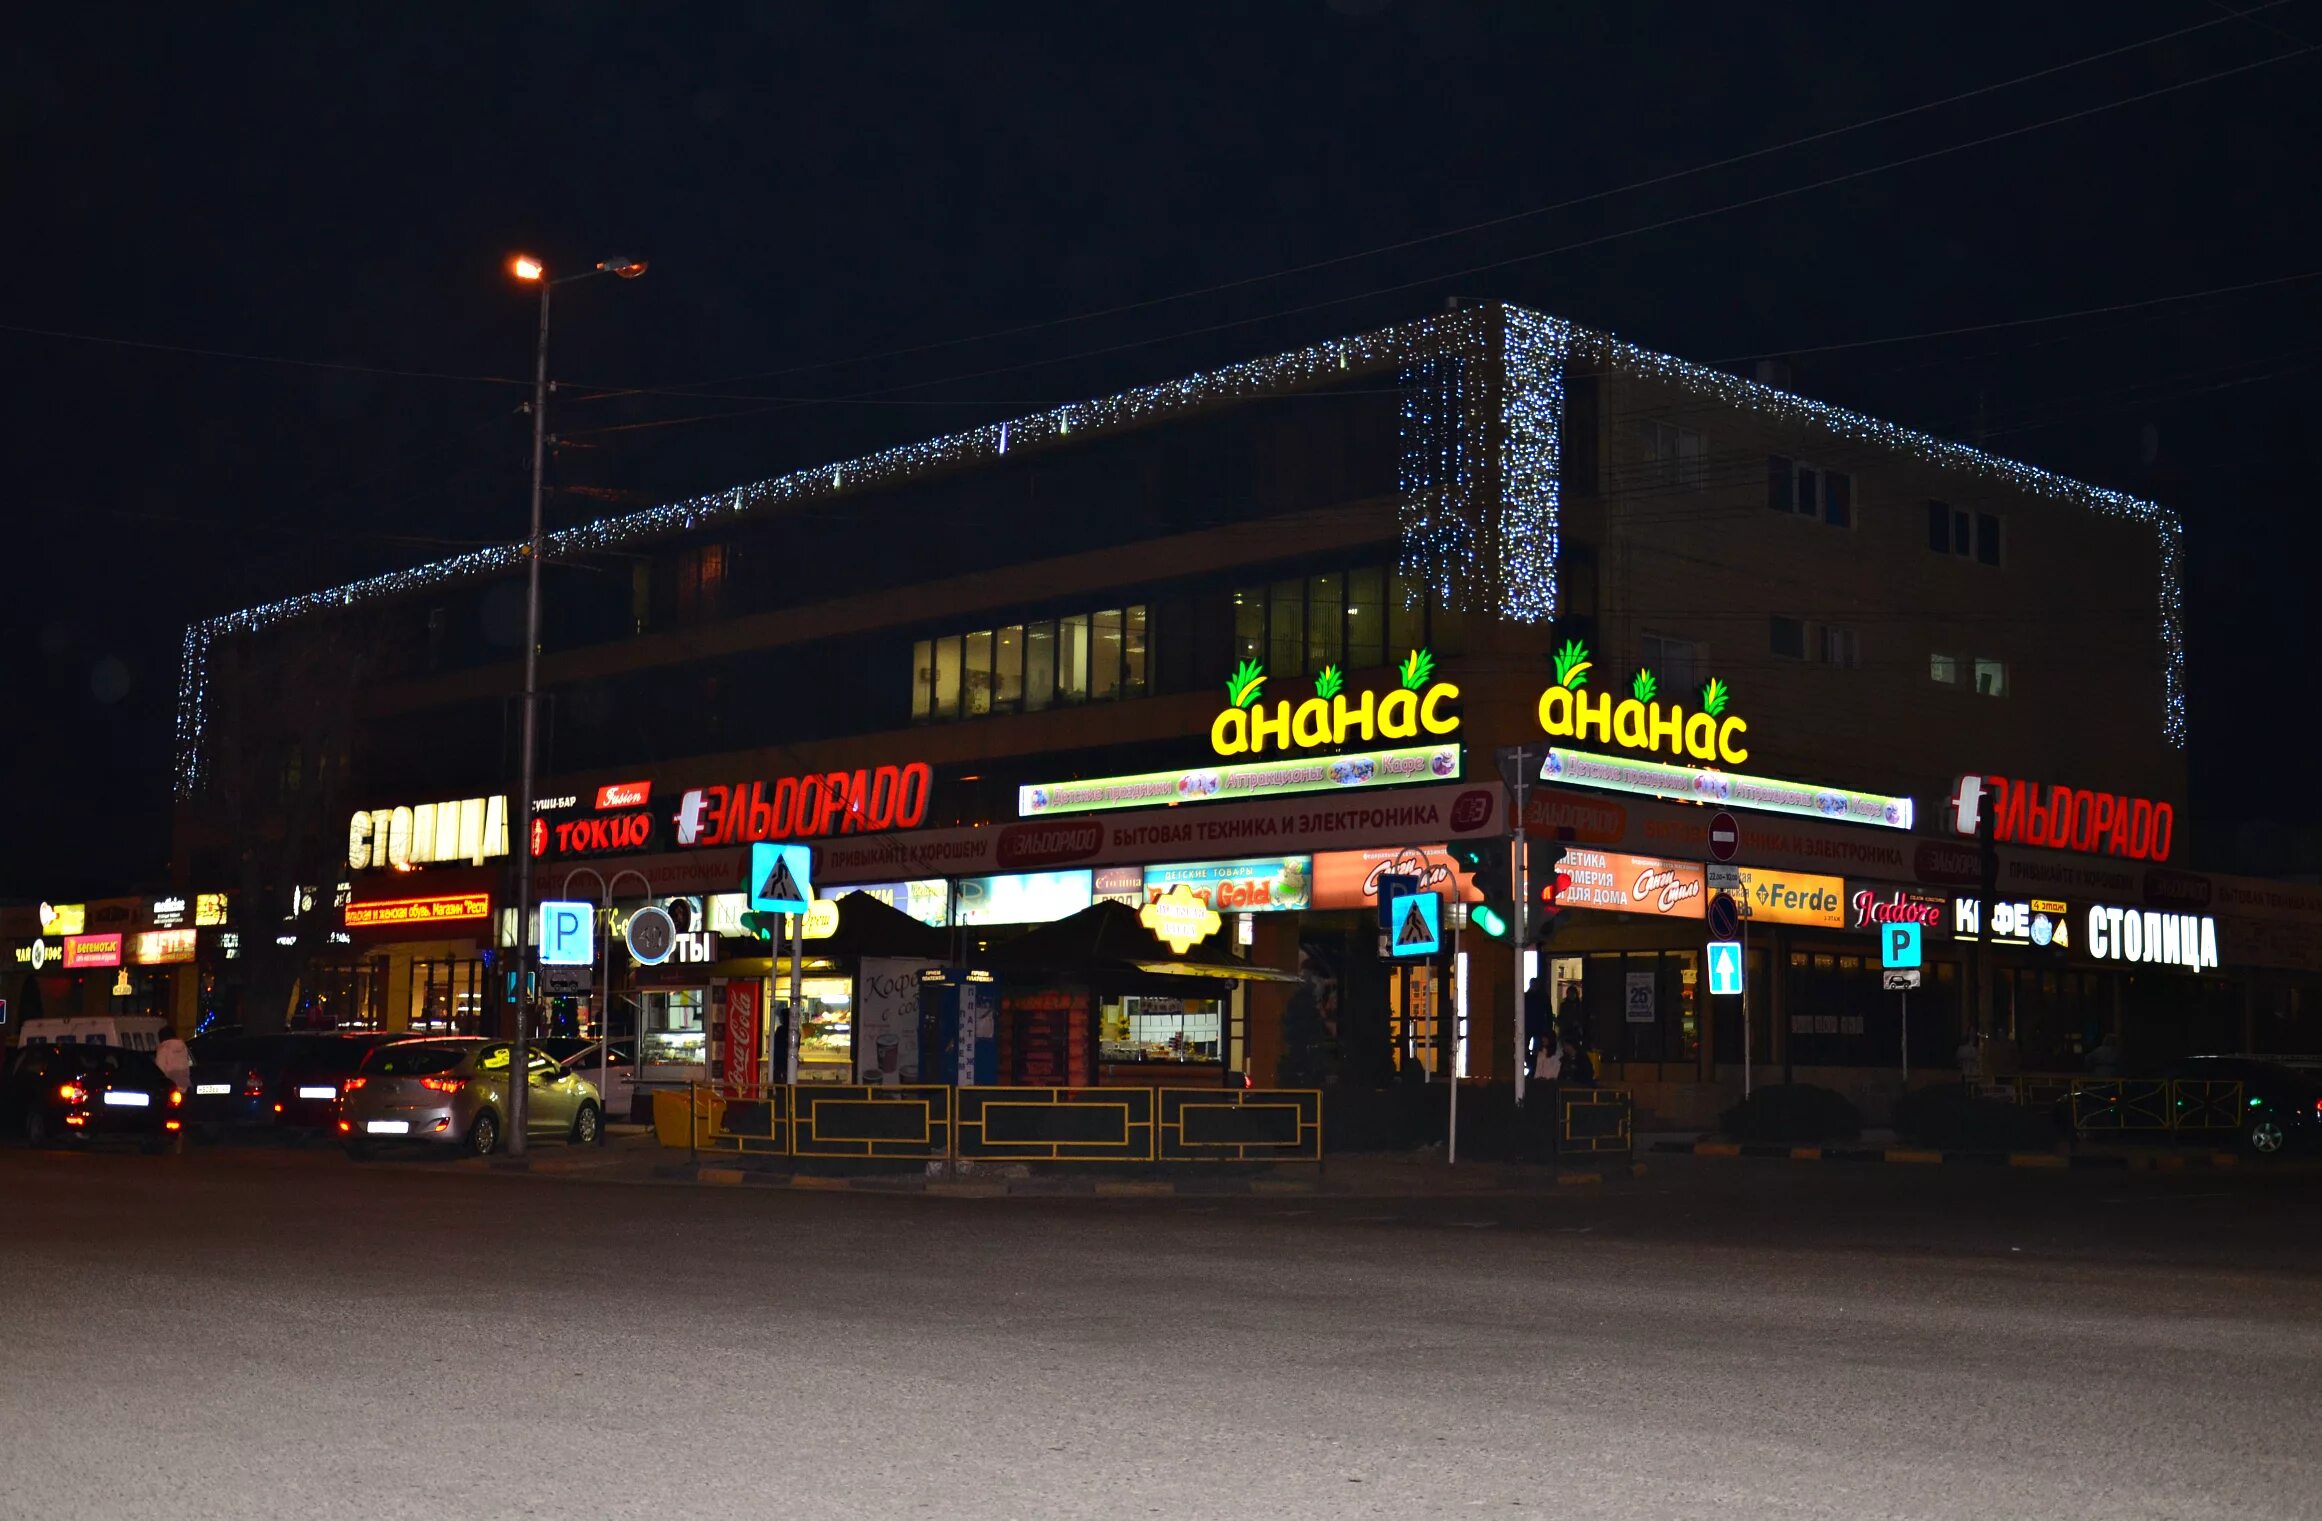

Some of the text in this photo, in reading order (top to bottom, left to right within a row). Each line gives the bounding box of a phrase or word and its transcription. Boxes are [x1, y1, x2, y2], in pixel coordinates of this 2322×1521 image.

[1382, 755, 1425, 778] Кафе
[603, 787, 642, 807] Fusion
[1106, 782, 1172, 804] праздники
[350, 795, 510, 869] СТОЛИЦА
[555, 814, 650, 853] ТОКИО
[1112, 804, 1440, 847] БЫТОВАЯ ТЕХНИКА И ЭЛЕКТРОНИКА
[918, 840, 988, 861] ХОРОШЕМУ
[1165, 866, 1253, 881] ДЕТСКИЕ ТОВАРЫ
[1217, 878, 1271, 909] Gold
[1567, 886, 1591, 903] ДЛЯ
[1593, 889, 1628, 905] ДОМА
[1771, 883, 1838, 912] Ferde
[2033, 901, 2040, 910] 4
[433, 902, 463, 916] Магазин
[557, 912, 578, 950] P
[2088, 905, 2218, 973] СТОЛИЦА
[1891, 929, 1911, 960] P
